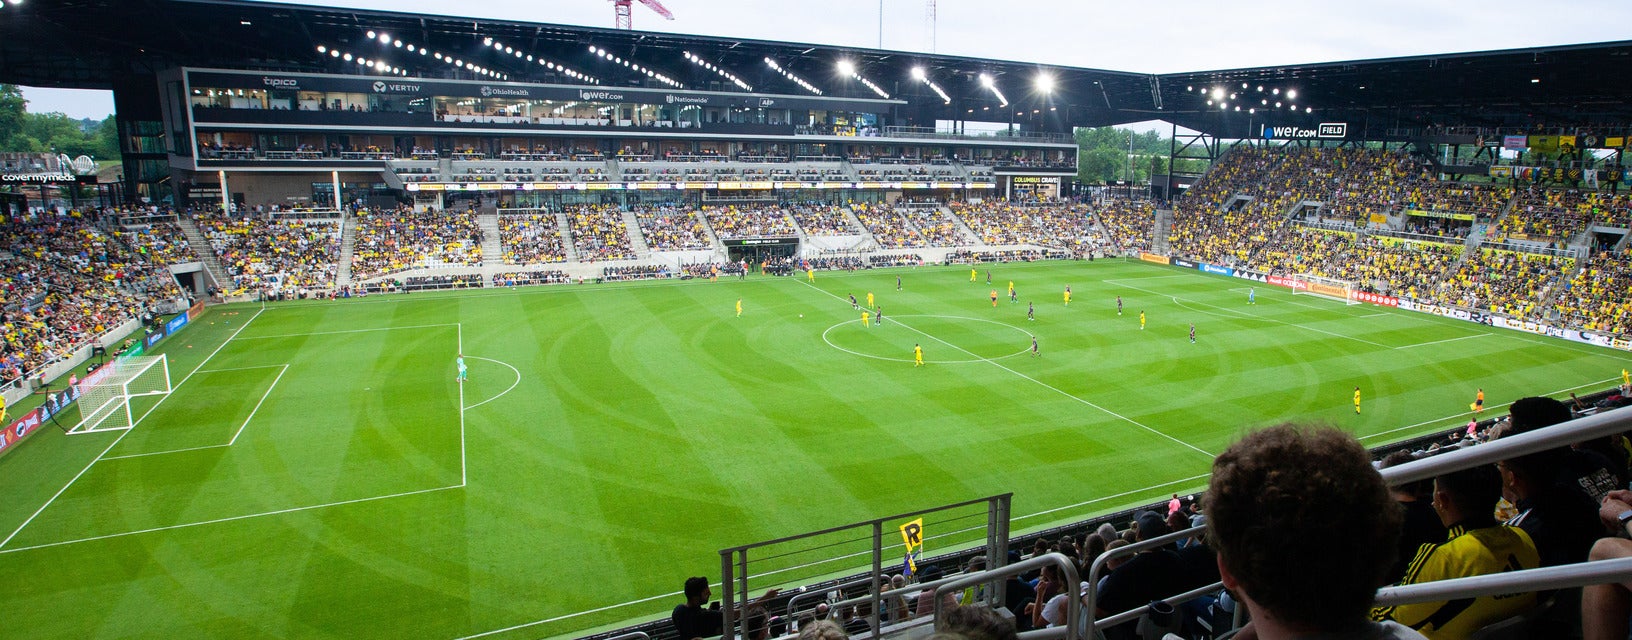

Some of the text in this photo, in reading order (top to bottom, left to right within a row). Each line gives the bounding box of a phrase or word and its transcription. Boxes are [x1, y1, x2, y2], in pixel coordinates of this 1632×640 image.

[263, 77, 297, 87] tipico
[389, 84, 420, 92] VERTIV
[493, 88, 529, 96] OhioHealth
[674, 96, 707, 104] Nationwide
[1322, 126, 1343, 134] FIELD
[1, 173, 76, 183] covermymeds
[904, 523, 921, 548] R
